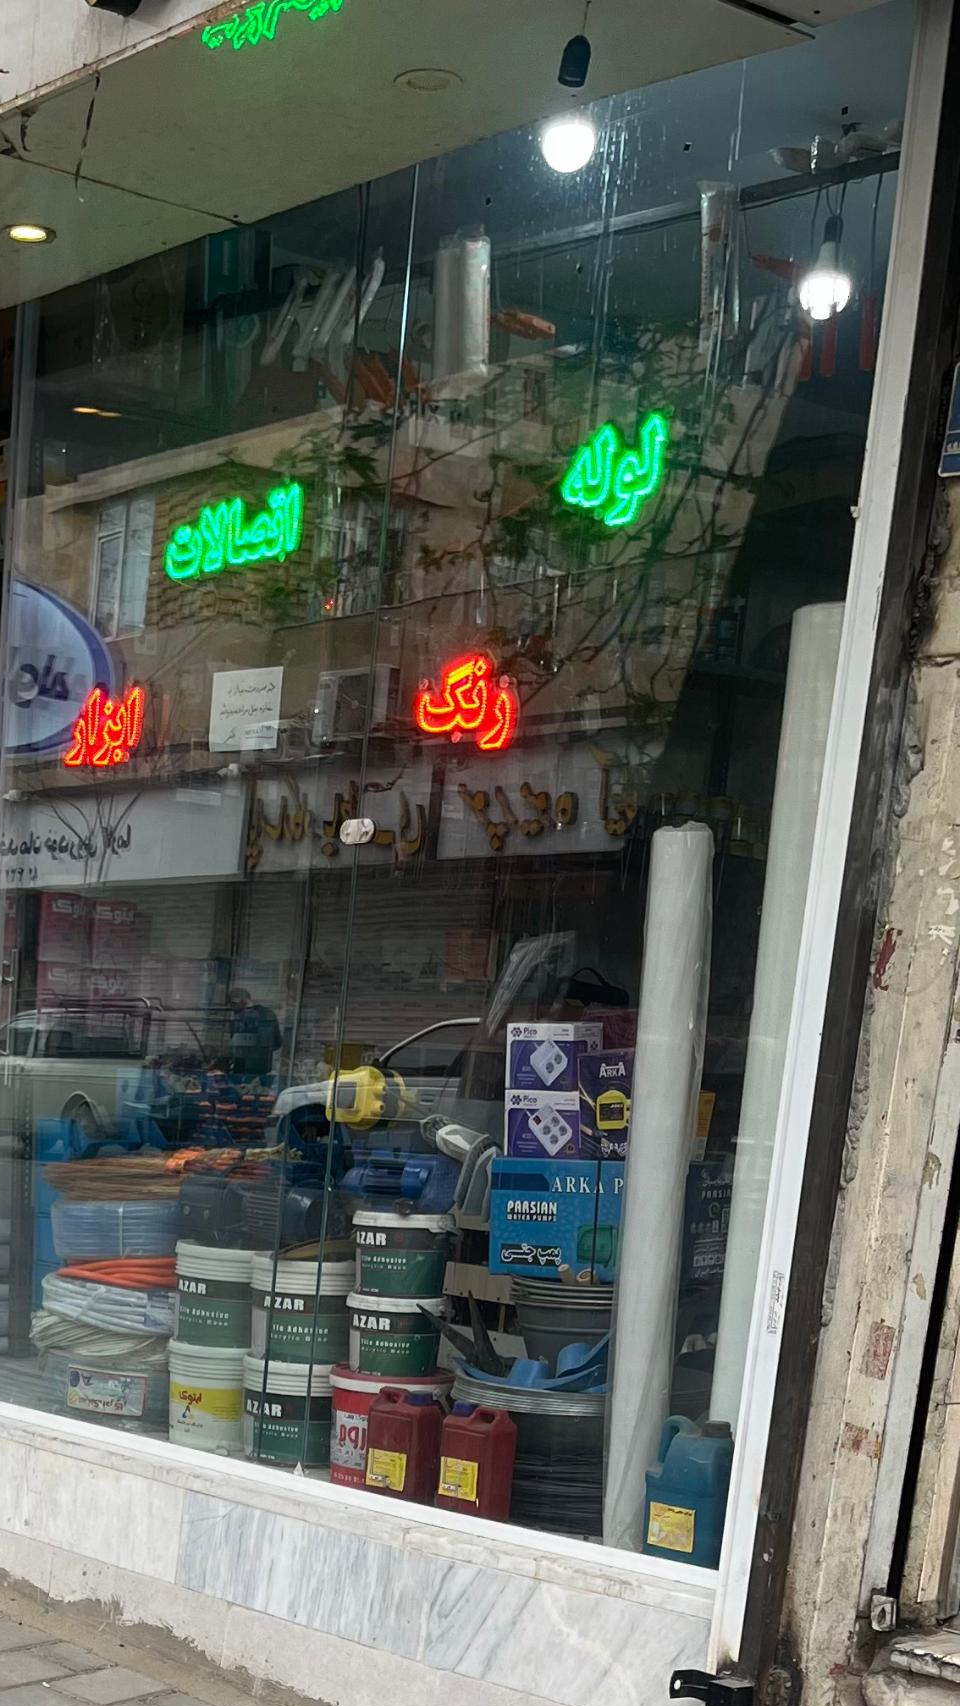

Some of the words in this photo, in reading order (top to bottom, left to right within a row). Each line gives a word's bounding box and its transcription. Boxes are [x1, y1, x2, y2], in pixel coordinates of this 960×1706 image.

[561, 411, 667, 528] لوله
[164, 482, 303, 580] اتصالات
[416, 655, 513, 752] رنگ
[63, 686, 144, 767] ابزار
[523, 1026, 538, 1036] Pico
[599, 1062, 626, 1079] ARKA
[522, 1095, 538, 1104] Pico
[701, 1189, 732, 1200] PARSIA
[506, 1199, 557, 1215] PARSIAN
[537, 1247, 562, 1266] پمپ
[178, 1278, 207, 1295] AZAR
[352, 1313, 391, 1331] AZAR
